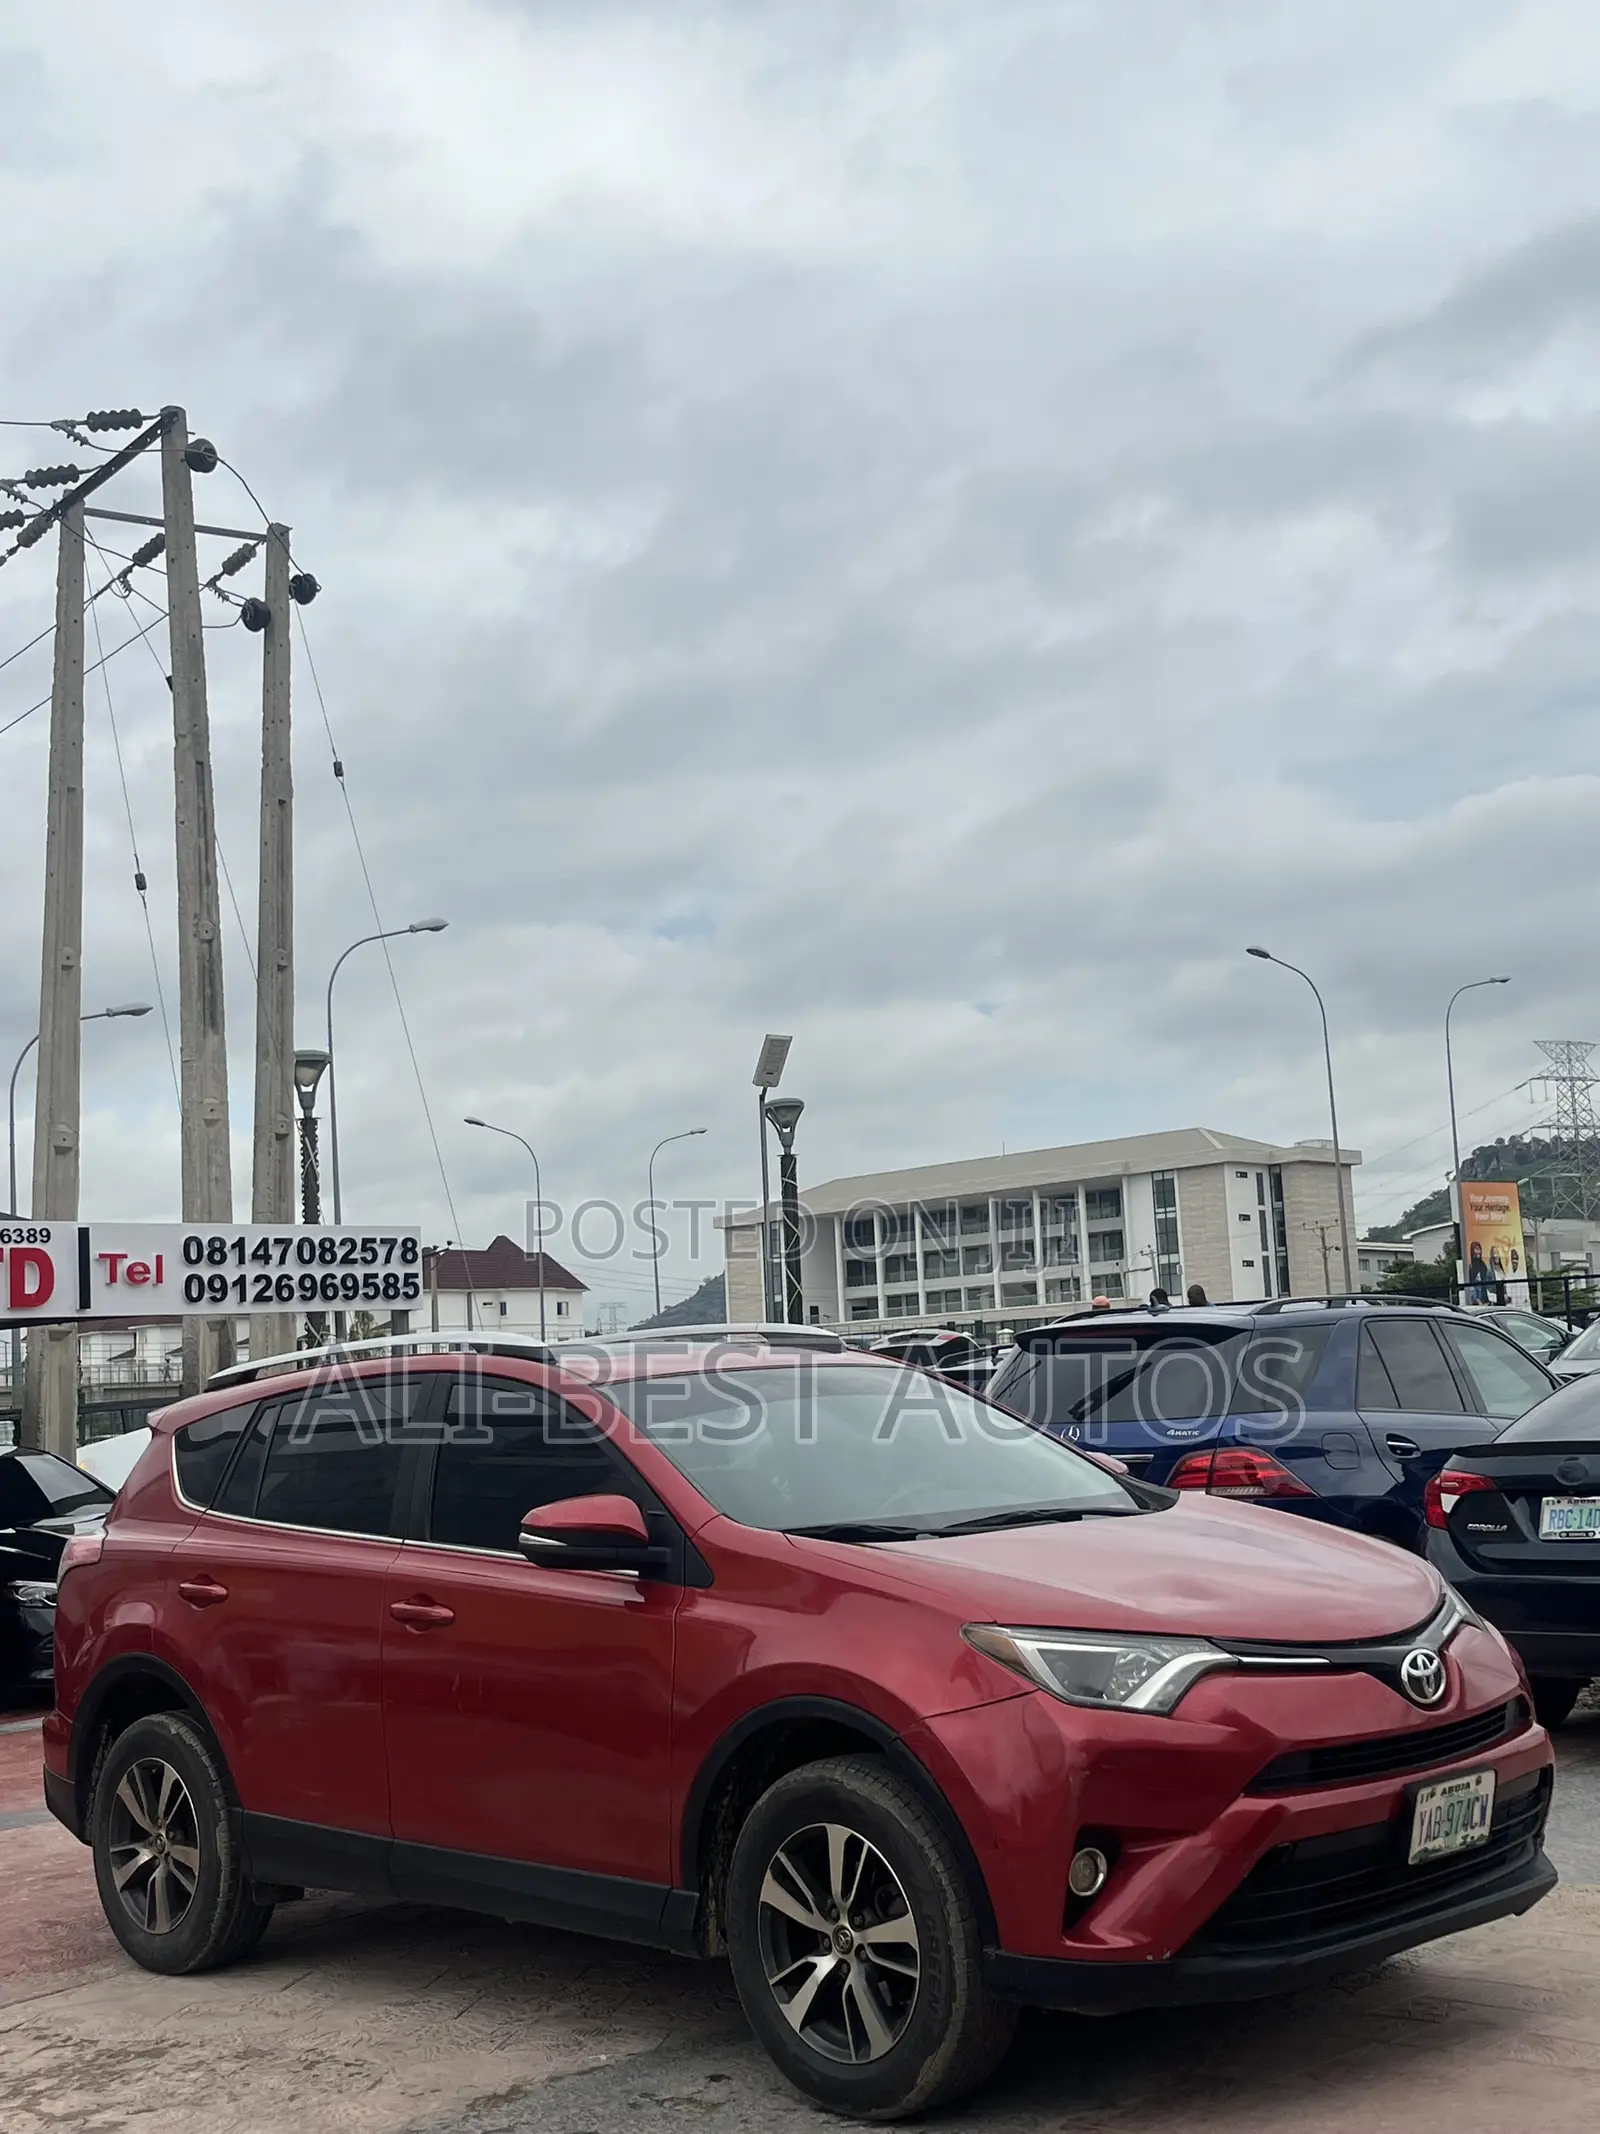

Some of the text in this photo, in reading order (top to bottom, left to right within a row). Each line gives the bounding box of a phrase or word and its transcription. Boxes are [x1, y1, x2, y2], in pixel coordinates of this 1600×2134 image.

[0, 1228, 51, 1244] 6389
[182, 1236, 419, 1265] 08147082578
[98, 1252, 163, 1285] Tel
[183, 1272, 420, 1303] 09126969585
[1467, 1524, 1508, 1532] COROLLA
